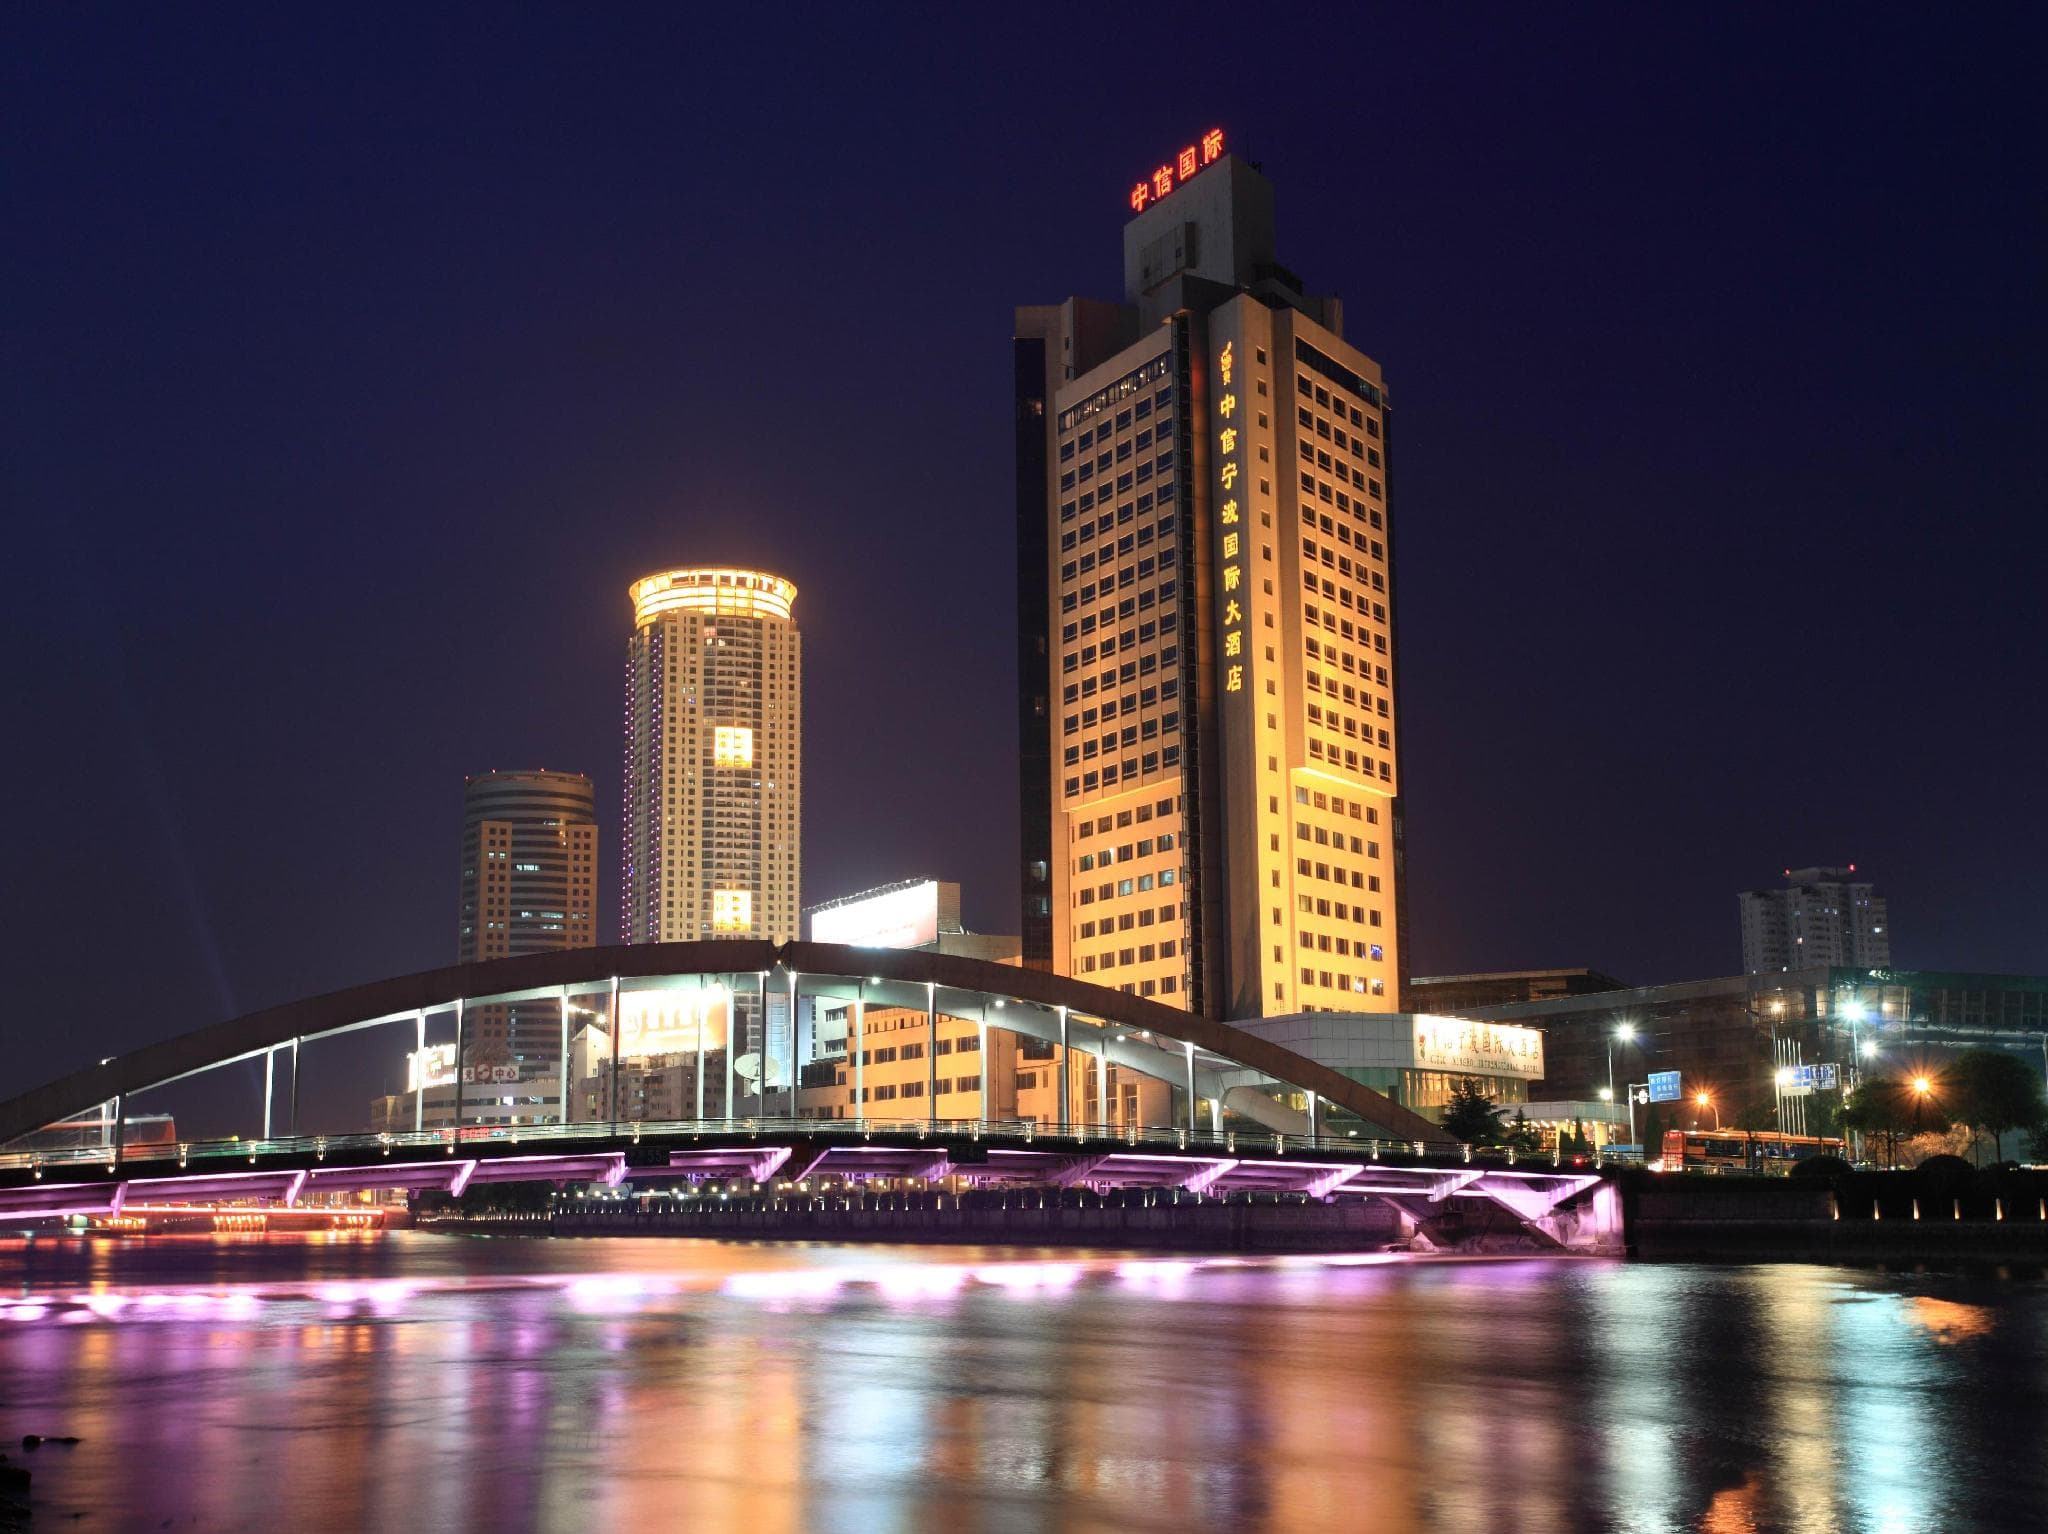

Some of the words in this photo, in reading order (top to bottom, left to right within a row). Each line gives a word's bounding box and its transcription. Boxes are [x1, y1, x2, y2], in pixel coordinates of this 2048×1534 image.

[1131, 128, 1225, 212] 中信国际
[1220, 393, 1243, 692] 中信宁波国际大酒店
